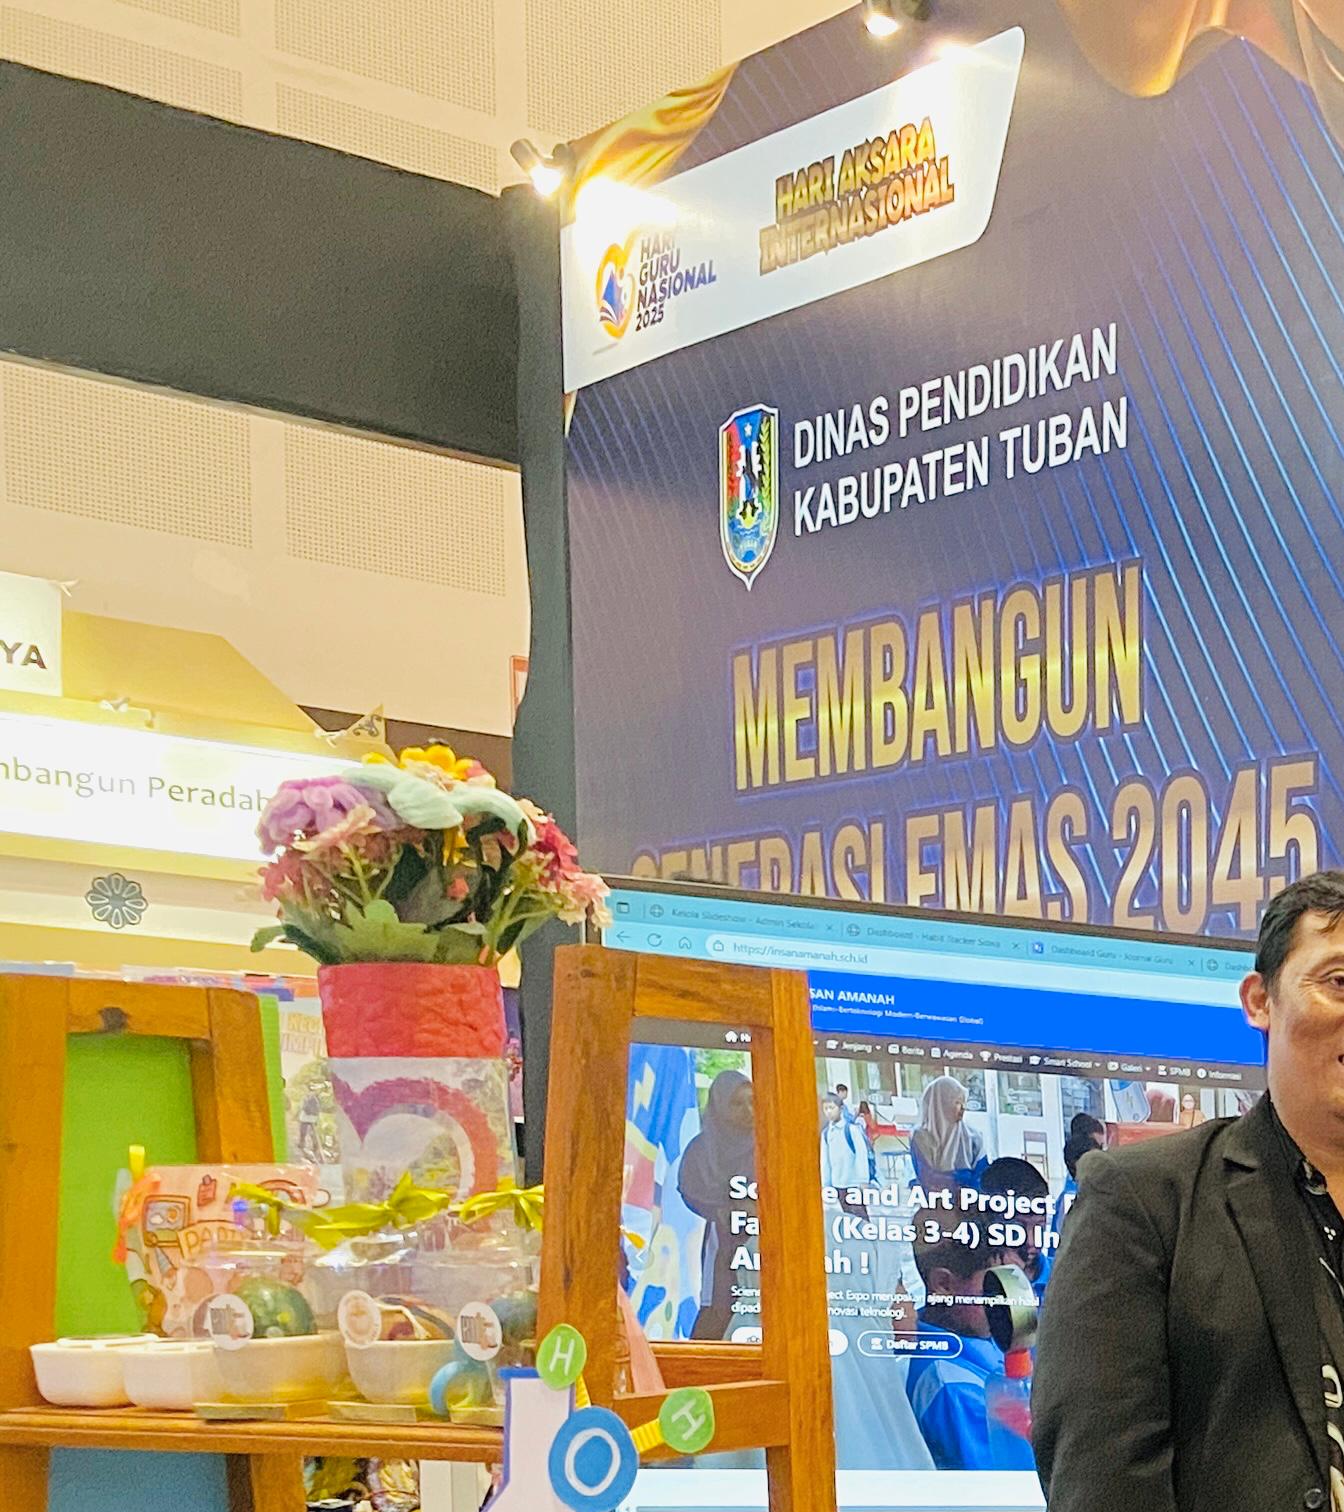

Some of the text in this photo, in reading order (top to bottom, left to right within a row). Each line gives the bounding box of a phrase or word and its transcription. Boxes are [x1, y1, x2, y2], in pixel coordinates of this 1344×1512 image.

[775, 116, 937, 226] HARI AKSARA
[759, 155, 955, 277] INTERNASIONAL
[636, 259, 717, 311] NASIONAL
[639, 247, 681, 284] GURU
[635, 303, 665, 332] 2025
[793, 322, 1119, 471] DINAS PENDIDIKAN
[793, 396, 1129, 537] KABUPATEN TUBAN
[731, 562, 1145, 792] MEMBANGUN
[1111, 756, 1320, 938] 2045
[838, 991, 895, 1006] AMANAH
[845, 1185, 899, 1207] and
[907, 1186, 953, 1211] Art
[960, 1188, 1057, 1218] Project
[832, 1217, 1028, 1250] (Kelas 3-4) SD
[548, 1336, 577, 1374] H
